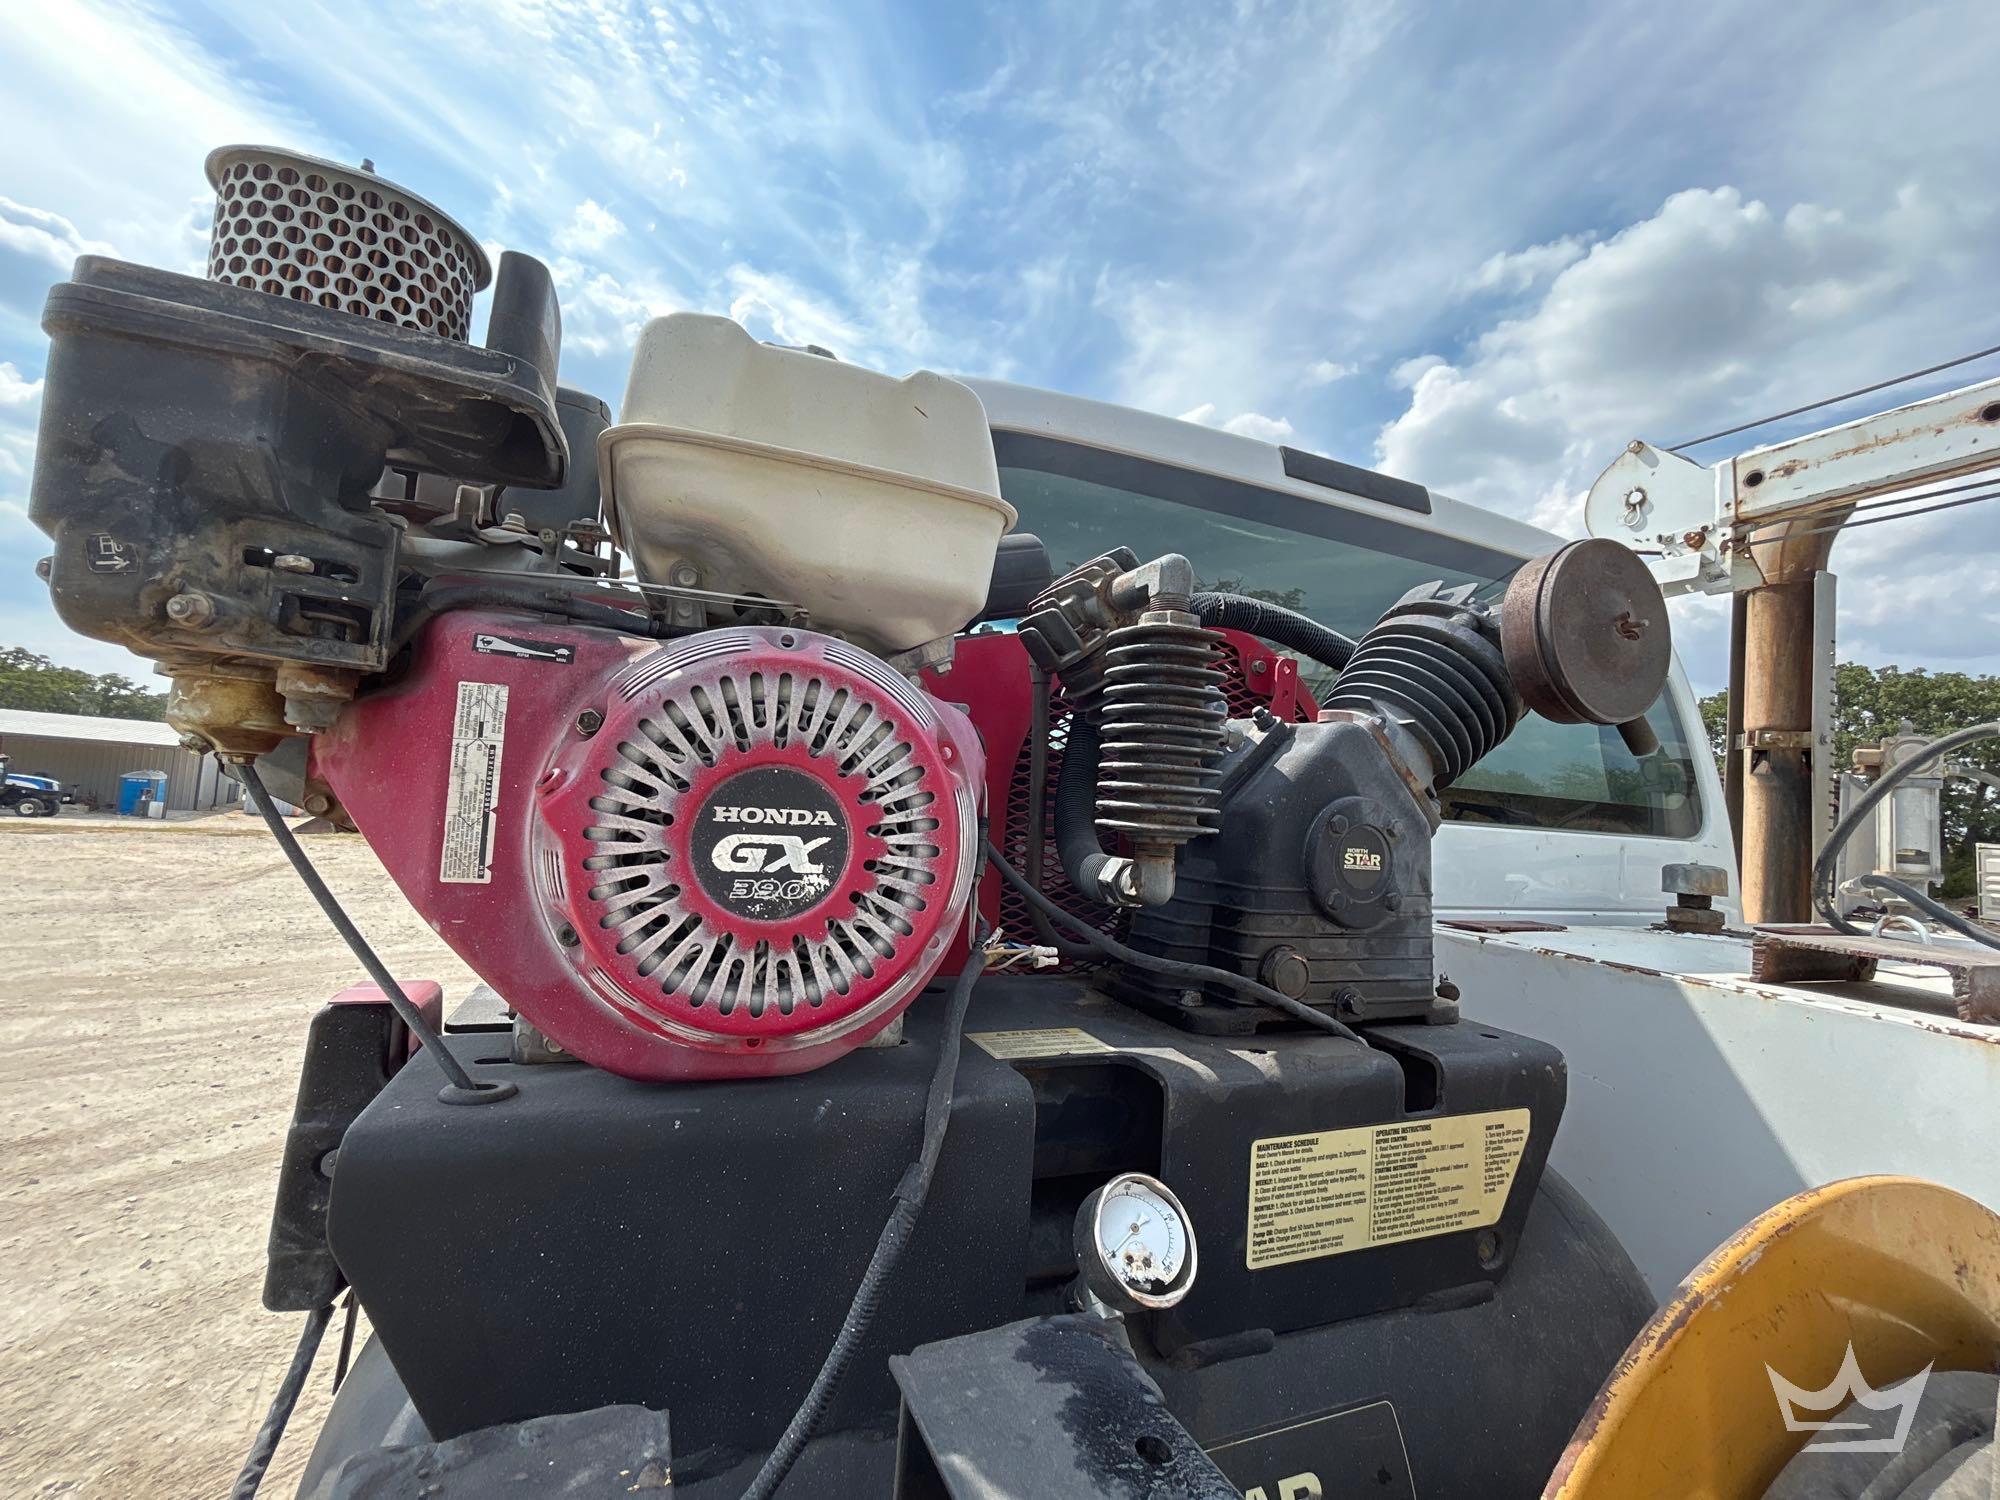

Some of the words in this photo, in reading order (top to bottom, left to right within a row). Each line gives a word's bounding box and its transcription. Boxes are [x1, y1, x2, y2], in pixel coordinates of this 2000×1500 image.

[712, 806, 837, 826] HONDA
[712, 834, 832, 873] GX
[1344, 852, 1381, 866] STAR
[729, 878, 807, 899] 390
